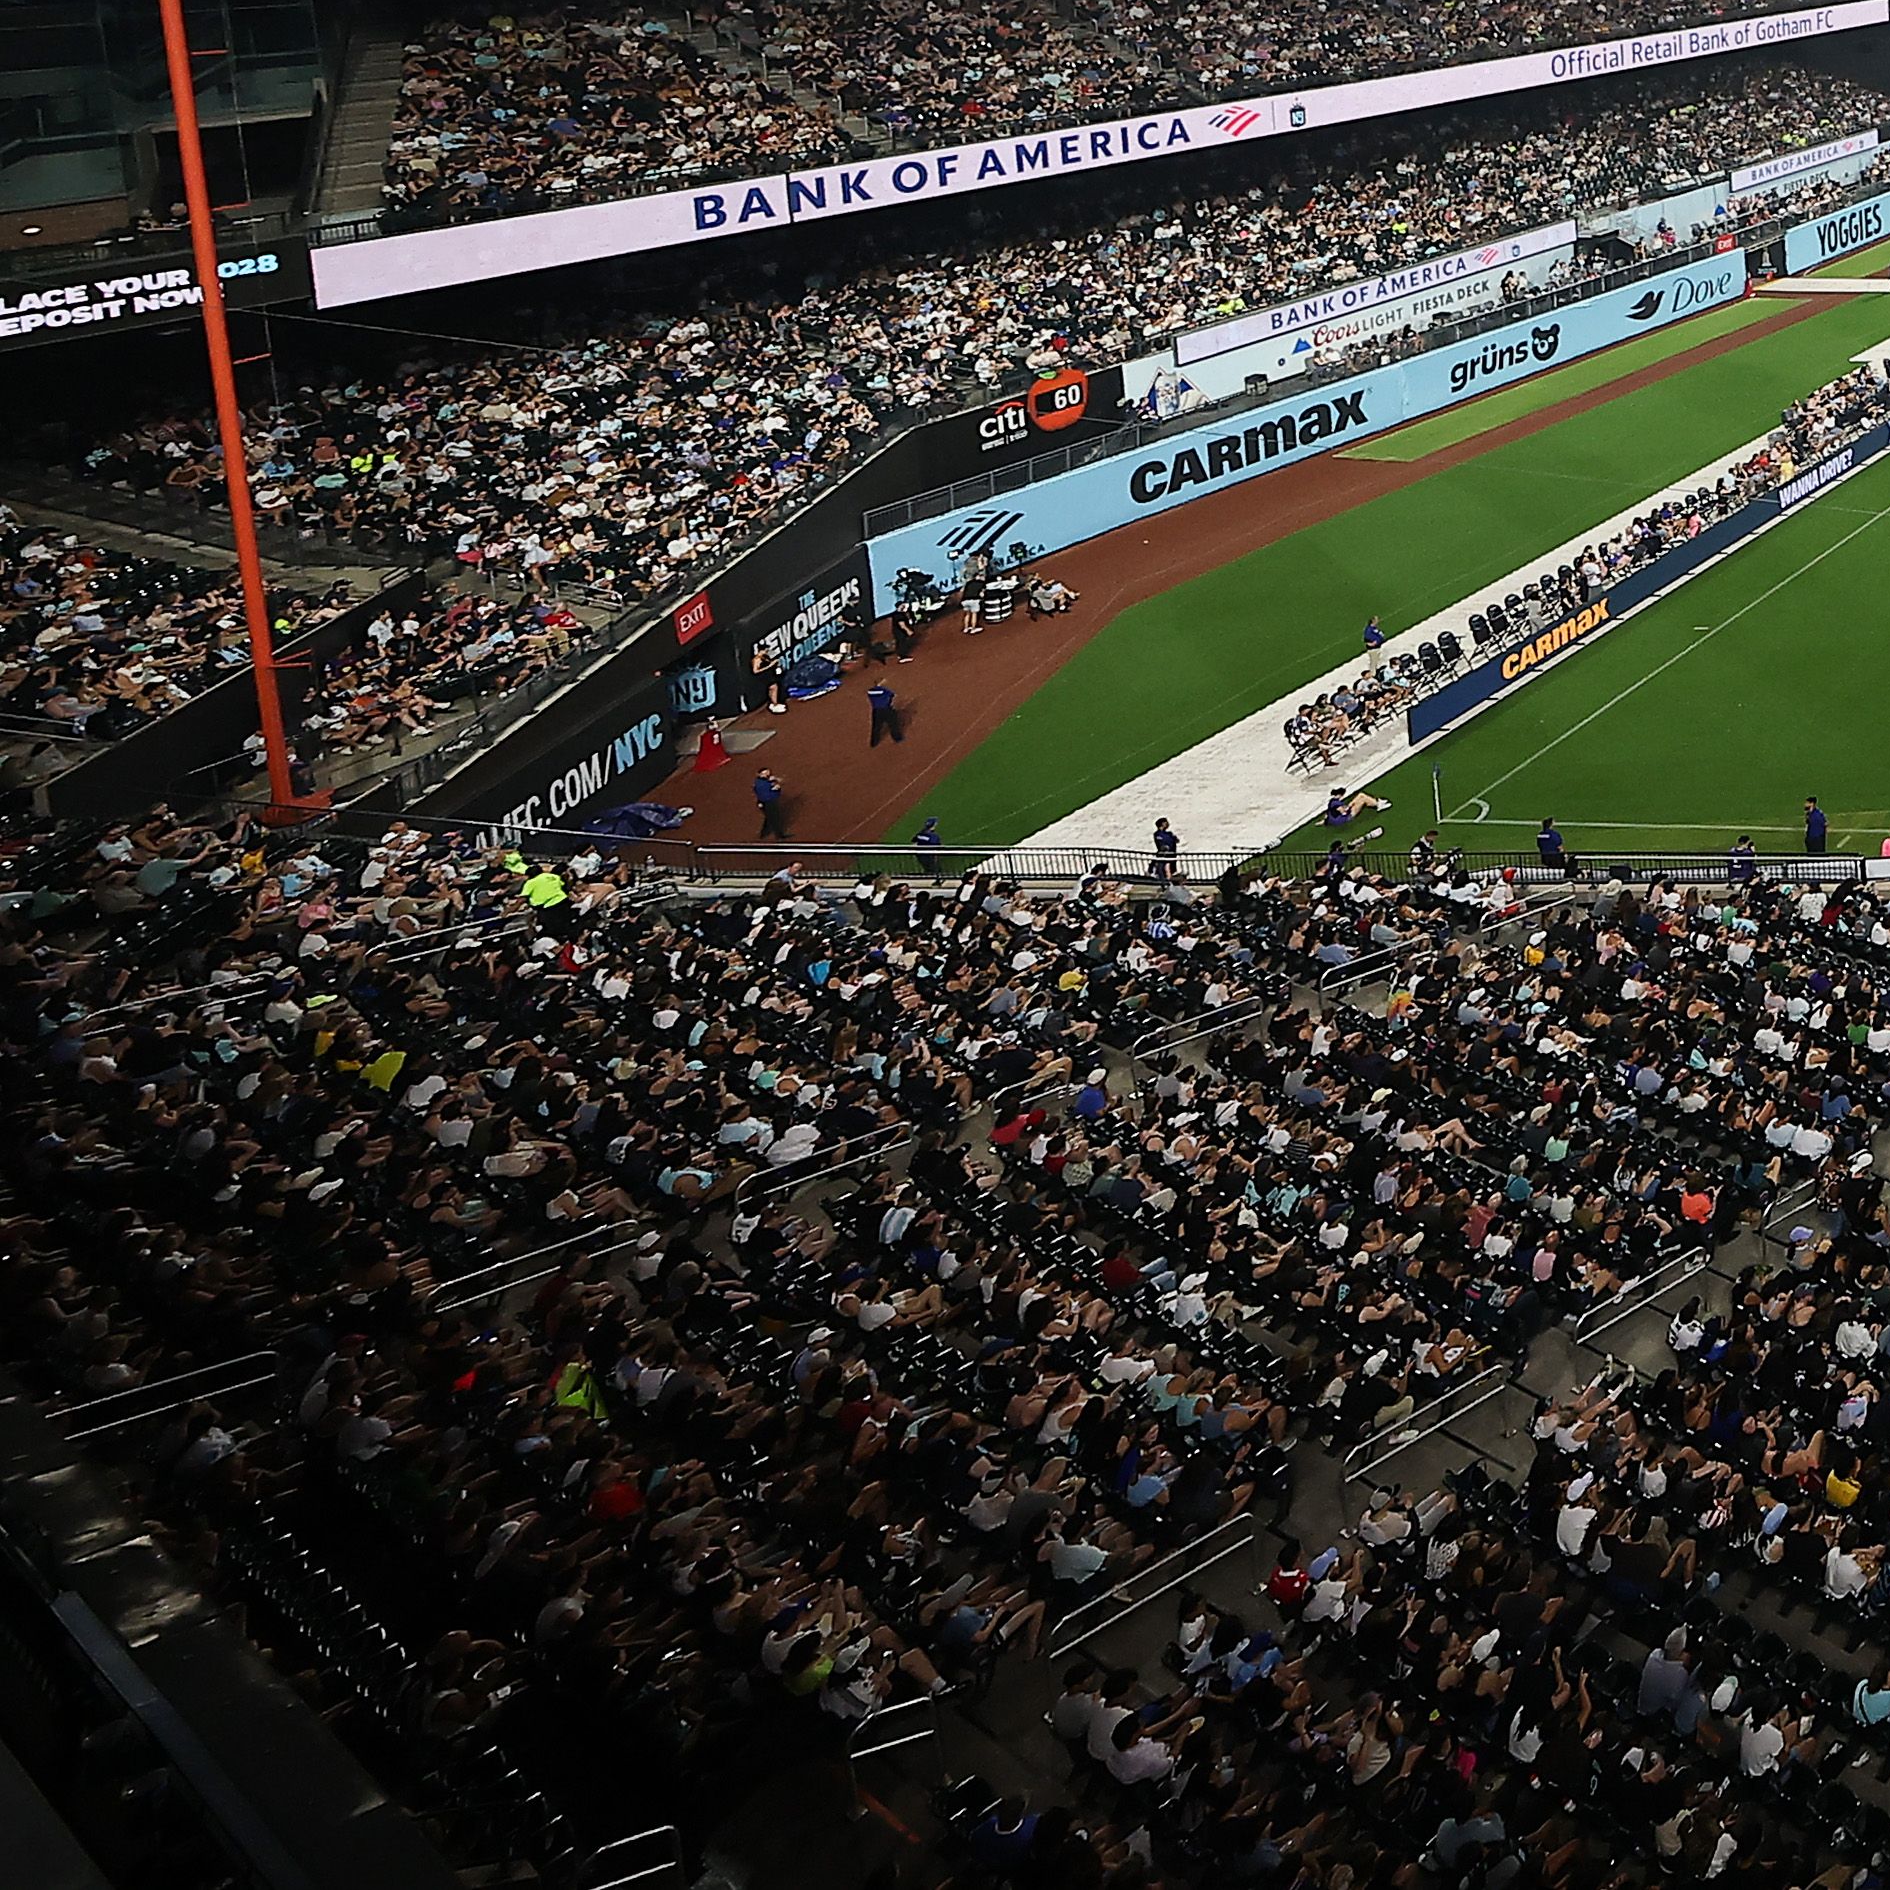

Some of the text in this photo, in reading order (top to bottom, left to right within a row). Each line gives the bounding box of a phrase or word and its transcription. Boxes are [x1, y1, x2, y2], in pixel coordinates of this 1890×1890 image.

[1551, 9, 1834, 78] Official Retail Bank of Gotham FC
[694, 117, 1191, 230] BANK OF AMERICA
[1750, 146, 1839, 181] BANK OF AMERICA
[1816, 203, 1883, 257] YOGGIES
[94, 269, 190, 298] YOUR
[216, 254, 279, 278] 028
[1671, 271, 1732, 313] Dove
[1271, 257, 1468, 330] BANK OF AMERICA
[1311, 278, 1491, 348] Coors LIGHT FIESTA DECK
[1450, 341, 1529, 393] grüns
[979, 404, 1027, 440] citi
[1053, 384, 1081, 410] 60
[1778, 448, 1854, 509] WANNA DRIVE?
[679, 600, 706, 634] EXIT
[792, 577, 860, 640] QUEENS
